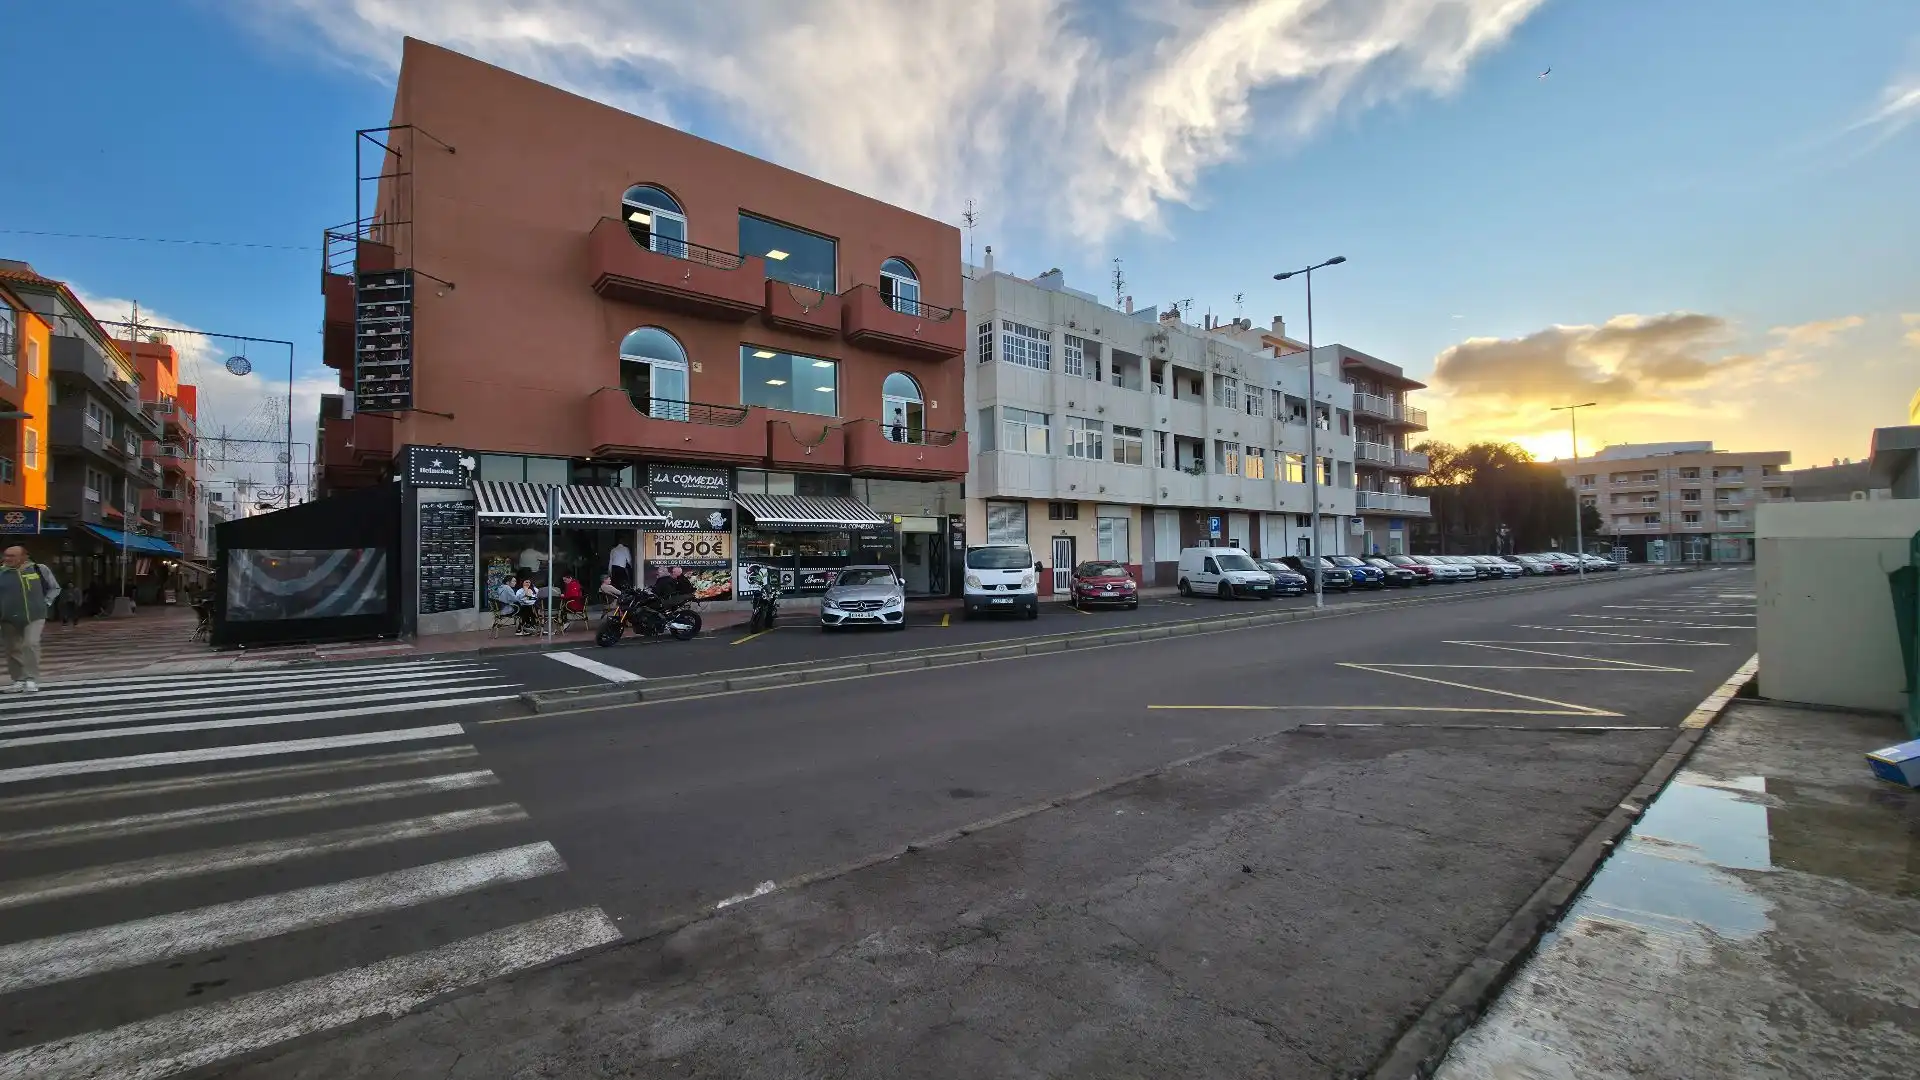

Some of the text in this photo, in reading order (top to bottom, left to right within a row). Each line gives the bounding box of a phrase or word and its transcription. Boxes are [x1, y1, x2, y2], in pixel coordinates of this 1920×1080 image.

[653, 473, 724, 486] LA COMEDIA
[499, 517, 513, 525] LA
[664, 519, 700, 529] MEDIA
[1211, 518, 1219, 531] P
[655, 541, 723, 557] 15,90€
